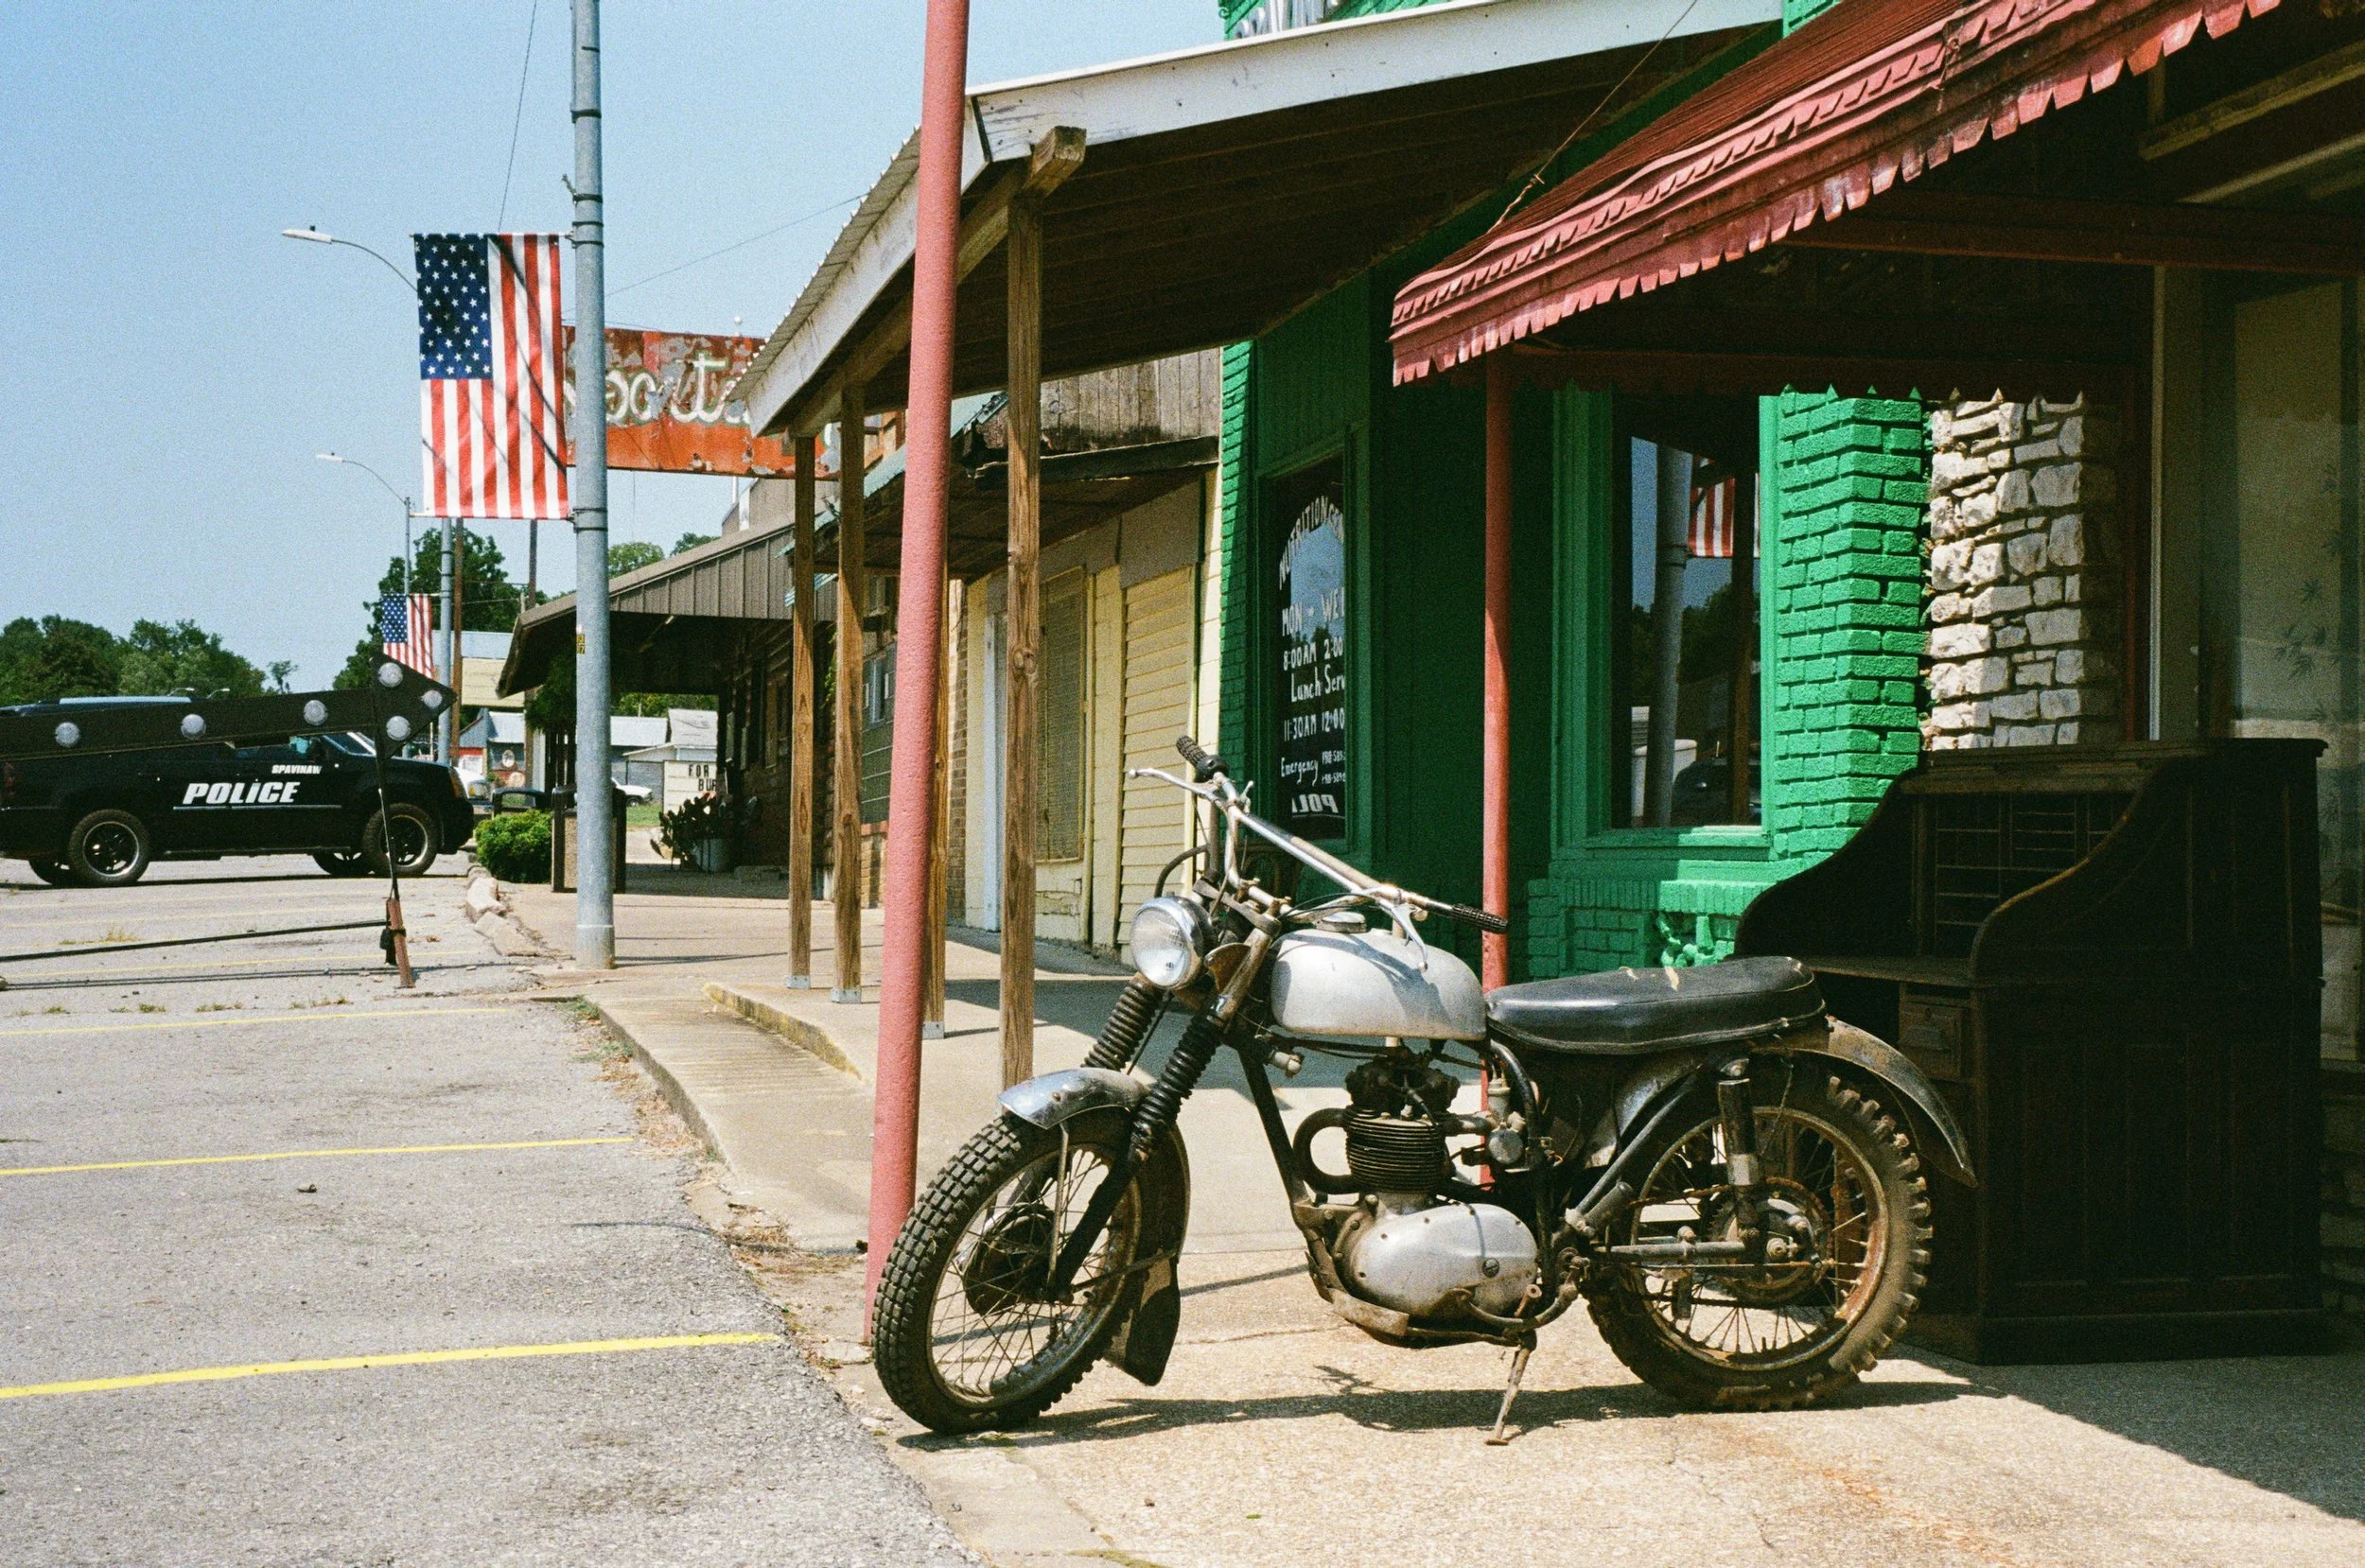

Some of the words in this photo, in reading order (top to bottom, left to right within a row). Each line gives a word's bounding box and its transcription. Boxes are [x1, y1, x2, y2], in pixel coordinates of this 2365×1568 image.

[1279, 496, 1328, 591] NUTRITION
[1282, 601, 1303, 637] MON
[1321, 586, 1344, 622] WE
[1283, 641, 1317, 671] 8:00AM
[1290, 666, 1321, 702] Lunch
[1284, 713, 1317, 742] 11:30AM
[1322, 707, 1345, 733] 12:00
[271, 764, 323, 775] SPAVINAW
[689, 764, 709, 776] FOR
[1280, 757, 1319, 787] Emergency
[182, 780, 302, 805] POLICE
